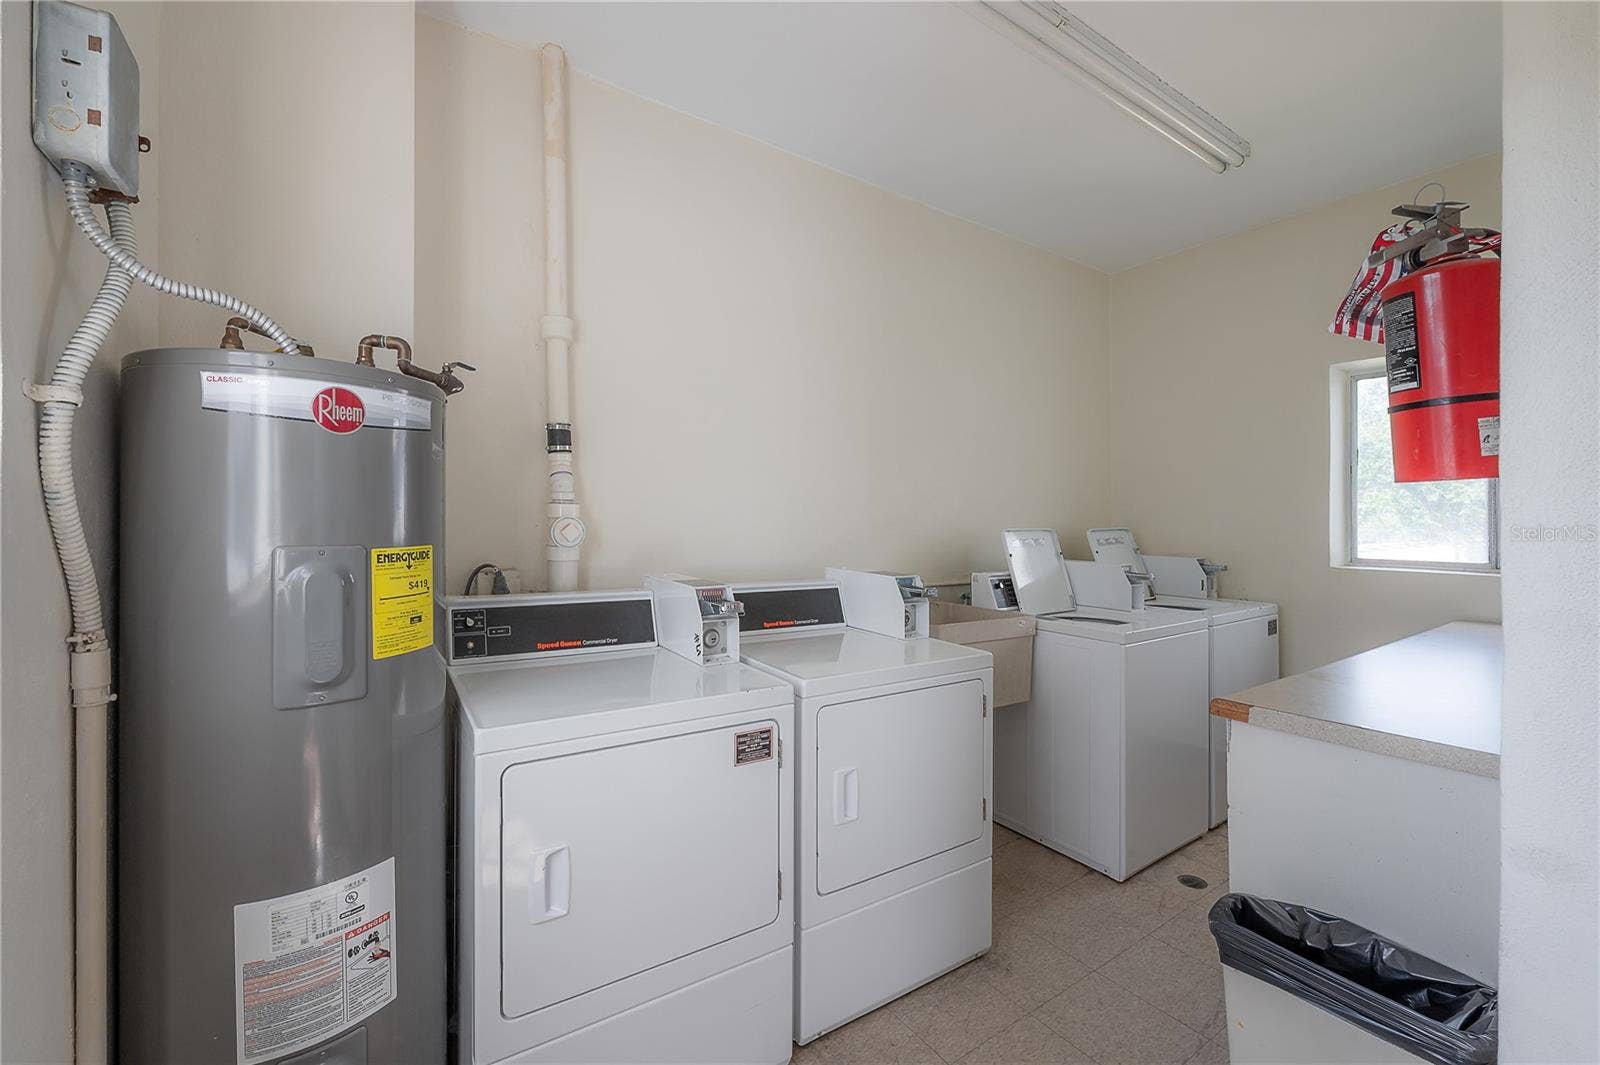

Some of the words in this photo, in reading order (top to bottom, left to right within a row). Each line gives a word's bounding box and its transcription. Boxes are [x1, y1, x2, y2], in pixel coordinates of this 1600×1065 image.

[206, 375, 243, 384] CLASSIC
[318, 388, 363, 427] Rheem
[537, 642, 559, 650] Speed
[560, 640, 582, 648] Queen
[582, 638, 606, 646] Commercial
[607, 637, 618, 645] Dryer
